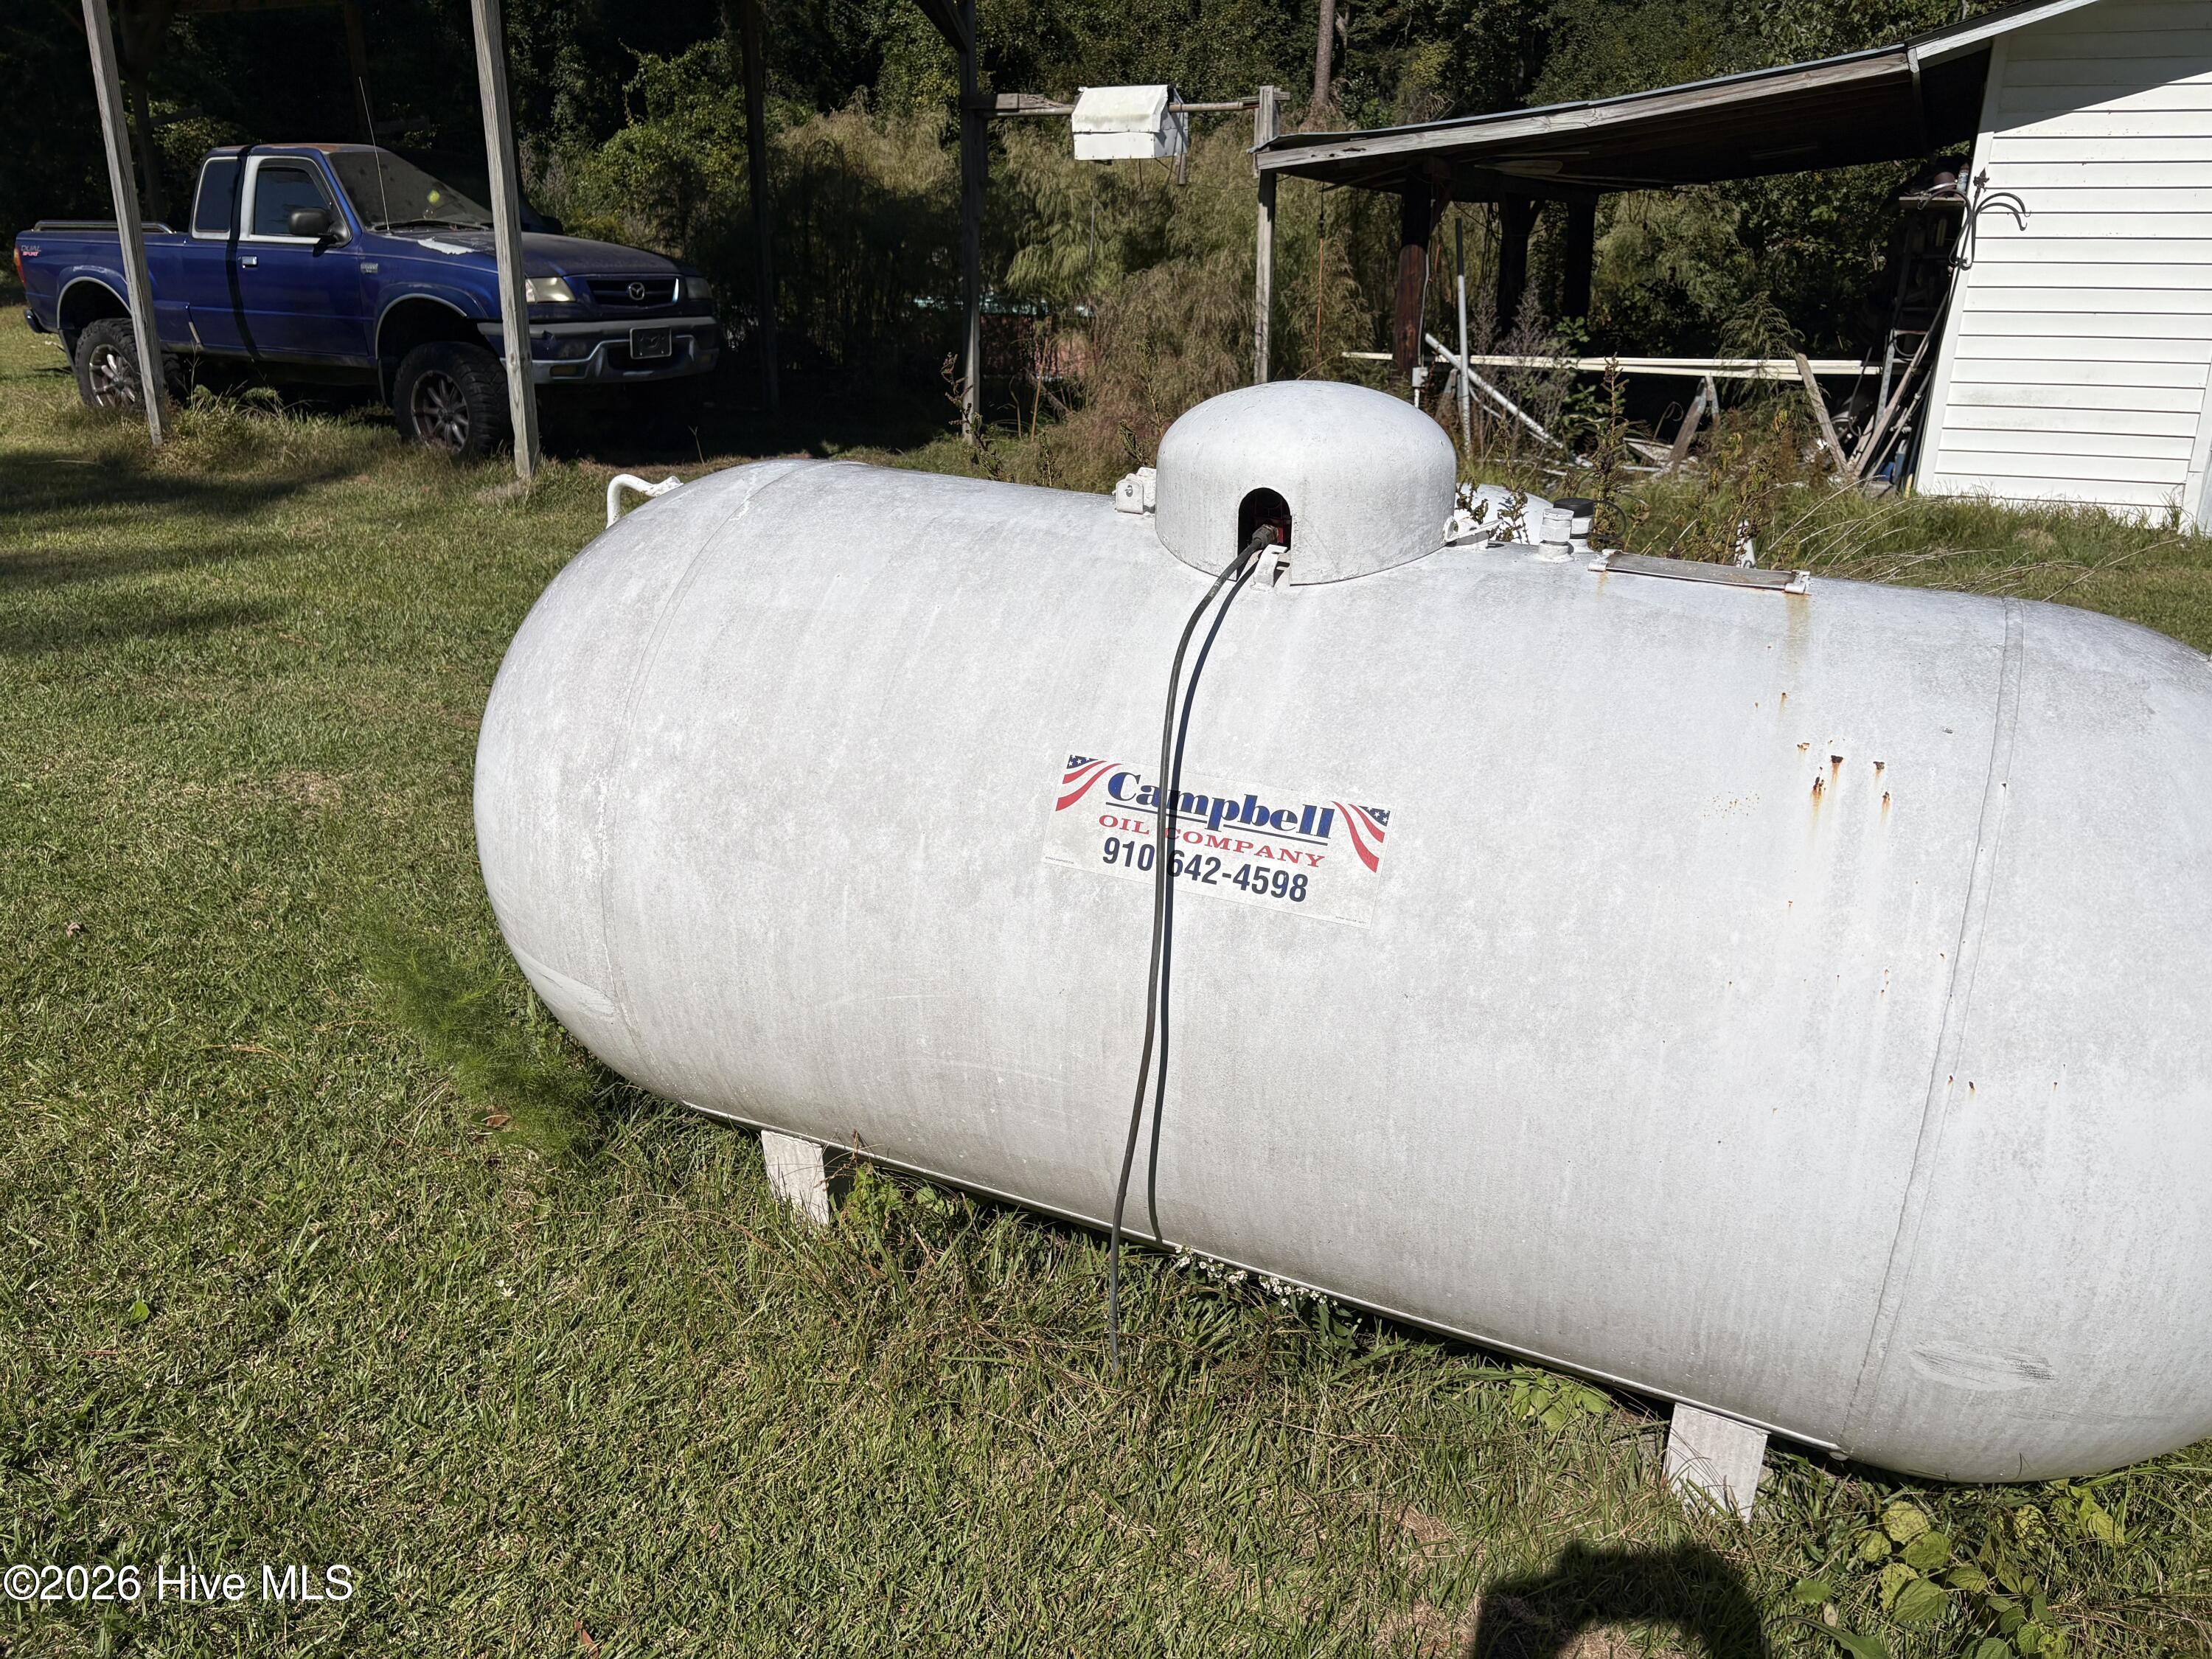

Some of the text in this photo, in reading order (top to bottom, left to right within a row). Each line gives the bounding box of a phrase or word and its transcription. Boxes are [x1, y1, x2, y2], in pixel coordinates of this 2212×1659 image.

[1107, 771, 1335, 839] Campbell
[1099, 815, 1325, 868] OIL COMPANY
